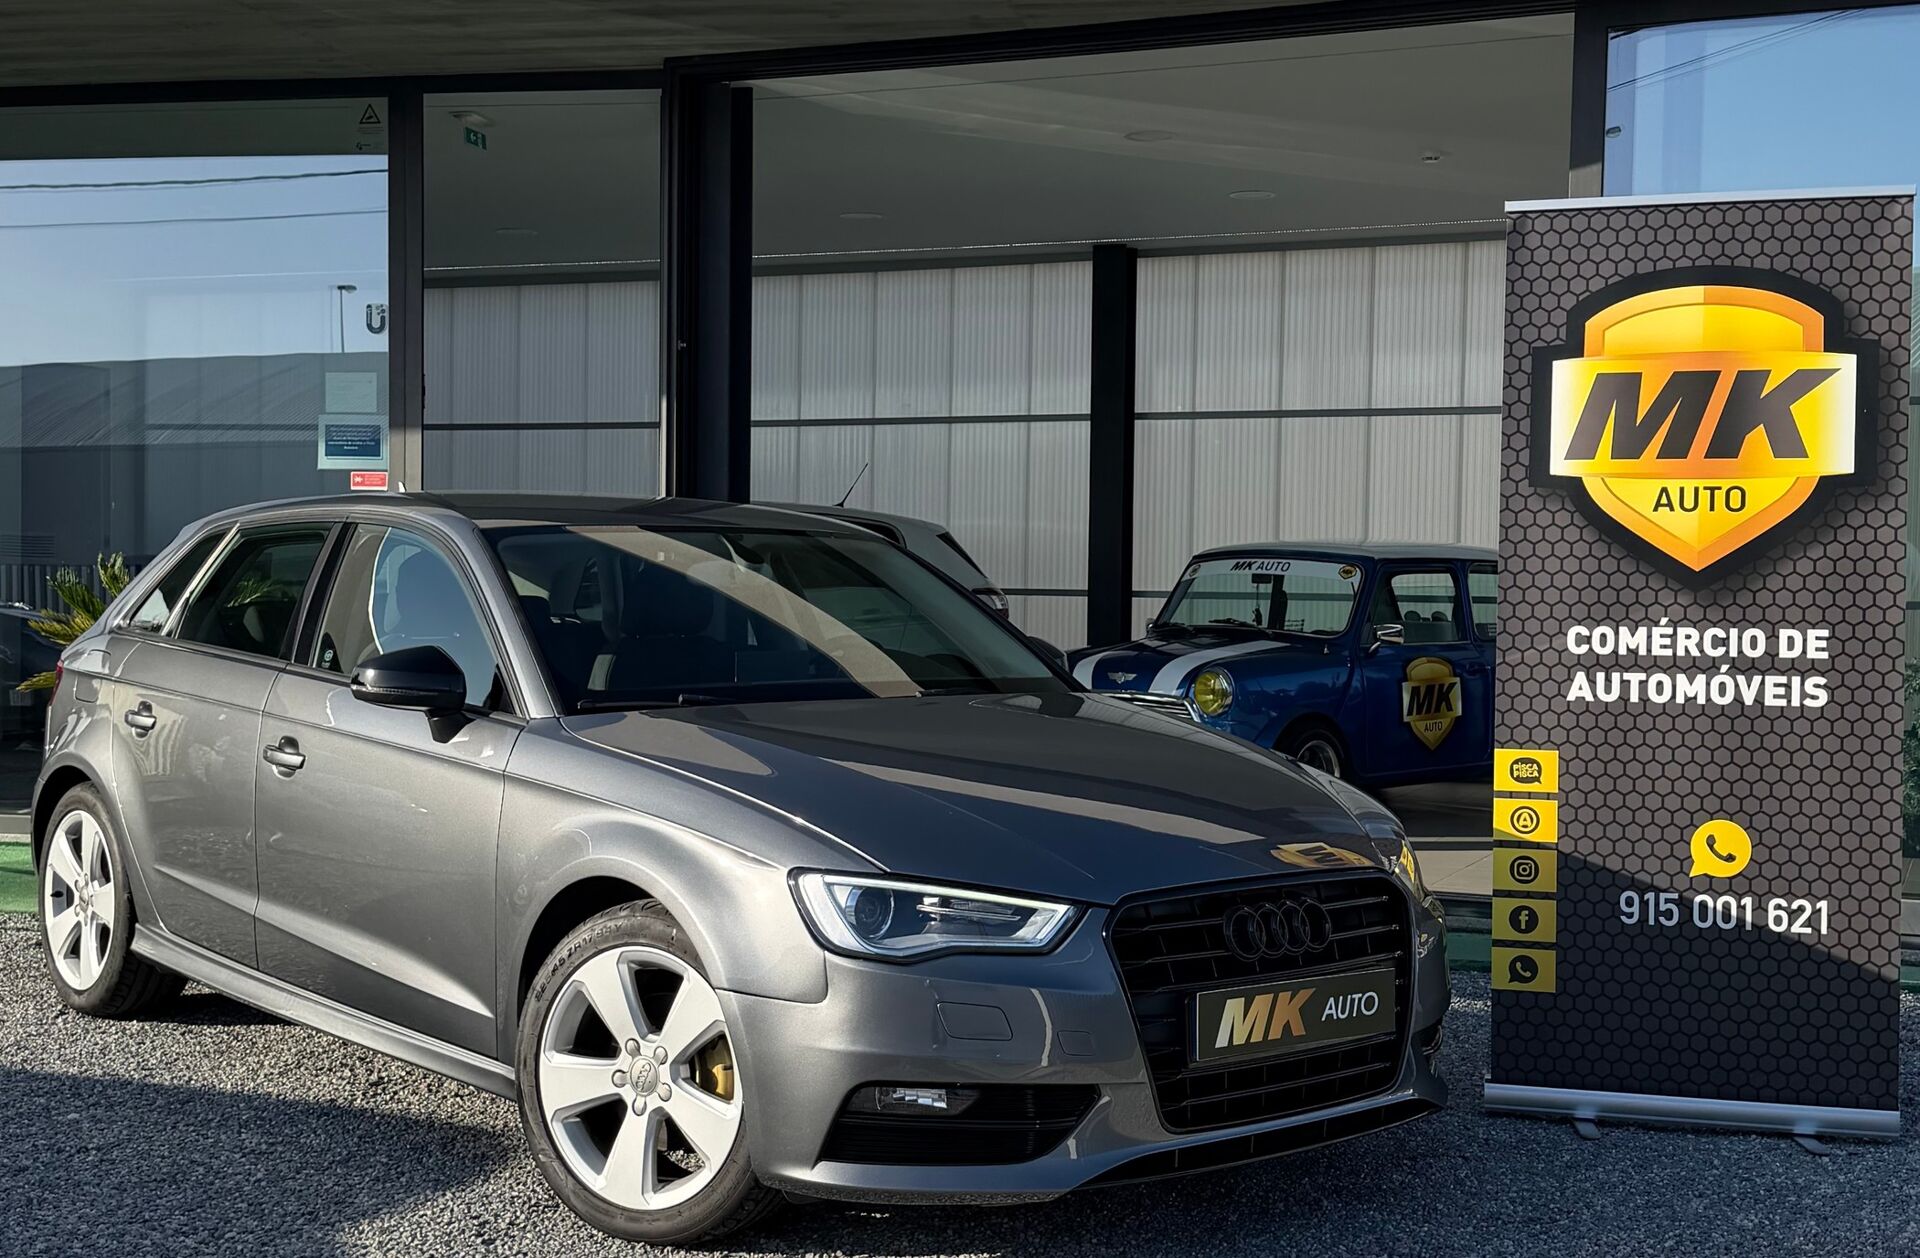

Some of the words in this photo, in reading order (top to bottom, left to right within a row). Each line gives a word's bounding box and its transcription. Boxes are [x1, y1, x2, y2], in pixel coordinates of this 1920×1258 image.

[1564, 367, 1842, 461] MK
[1652, 485, 1747, 513] AUTO
[1230, 560, 1257, 571] MK
[1256, 560, 1291, 572] AUTO
[1566, 617, 1767, 658] COMÉRCIO
[1778, 628, 1830, 659] DE
[1407, 681, 1458, 717] MK
[1566, 664, 1829, 708] AUTOMÓVEIS
[1423, 721, 1443, 733] AUTO
[1619, 890, 1680, 927] 915
[1692, 894, 1753, 931] 001
[1767, 897, 1829, 935] 621
[1214, 988, 1317, 1049] MK
[1321, 991, 1379, 1021] AUTO
